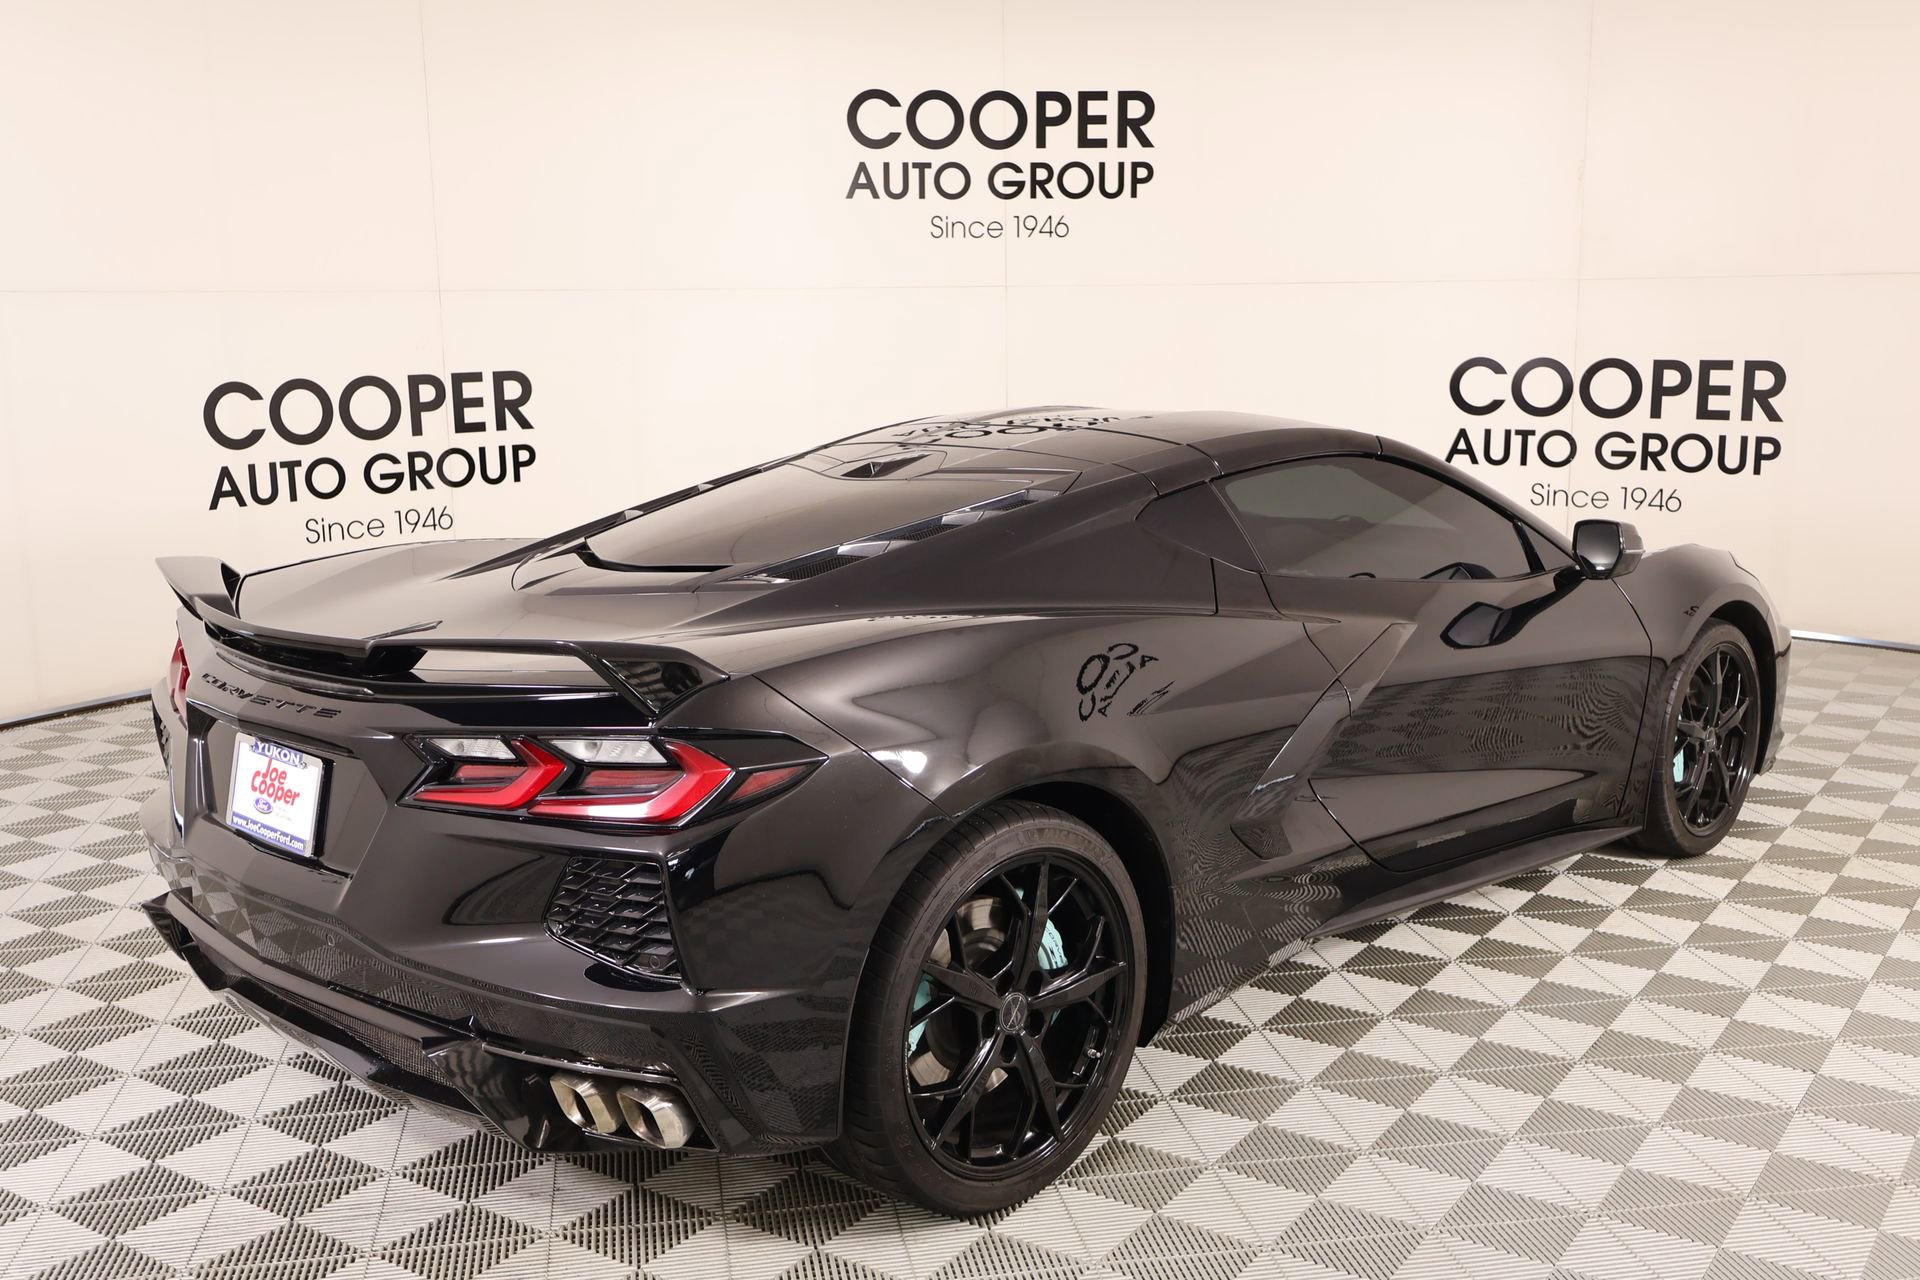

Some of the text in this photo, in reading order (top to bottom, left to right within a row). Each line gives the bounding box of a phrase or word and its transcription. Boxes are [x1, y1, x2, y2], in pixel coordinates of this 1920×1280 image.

[846, 89, 1155, 150] COOPER
[846, 162, 1154, 200] AUTO GROUP
[930, 216, 1070, 239] Since 1946
[1449, 357, 1786, 422] COOPER
[203, 371, 534, 450] COOPER
[1444, 428, 1781, 475] AUTO GROUP
[208, 444, 536, 510] AUTO GROUP
[1530, 483, 1682, 512] Since 1946
[305, 506, 454, 544] Since 1946
[202, 673, 342, 718] CORVETTE
[256, 741, 301, 765] YUKON
[262, 758, 288, 785] Joe
[250, 770, 301, 806] Cooper
[232, 815, 304, 850] www.JoeCooperFord.com
